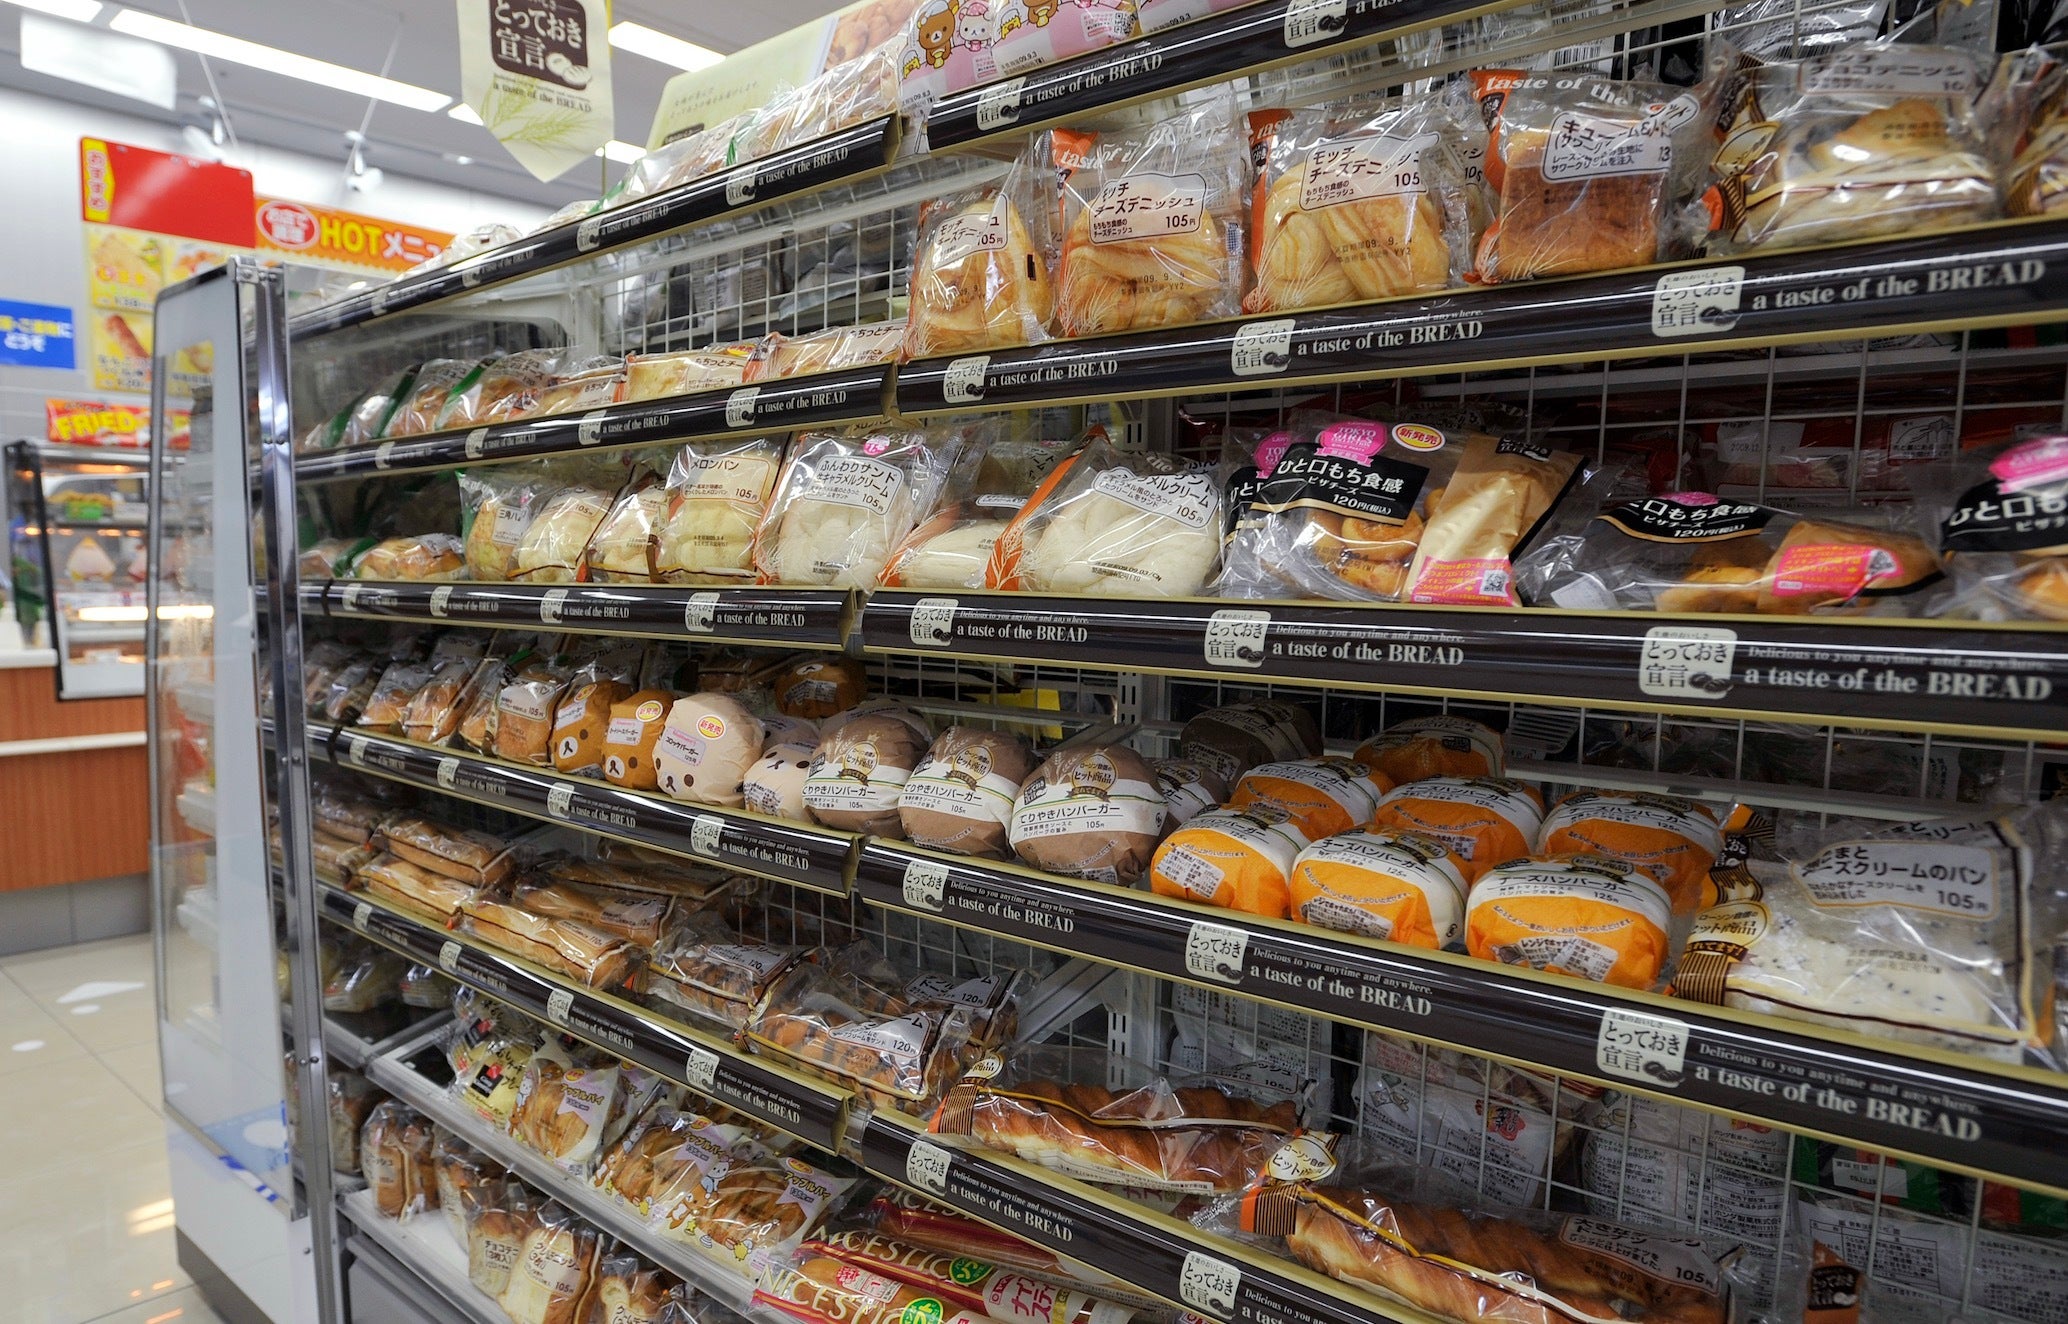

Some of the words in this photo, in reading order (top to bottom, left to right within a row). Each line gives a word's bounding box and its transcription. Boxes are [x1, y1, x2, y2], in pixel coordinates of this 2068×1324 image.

[495, 0, 582, 49] とっておき
[1288, 14, 1317, 40] 宣言
[496, 27, 546, 70] 宣言
[1026, 93, 1033, 105] a
[1037, 84, 1066, 102] taste
[1069, 77, 1084, 94] of
[1085, 71, 1105, 89] the
[1108, 53, 1163, 82] BREAD
[1486, 75, 1549, 91] taste
[1556, 75, 1584, 90] of
[1590, 84, 1628, 105] the
[556, 97, 591, 113] BREAD
[1314, 147, 1355, 165] モッチ
[1166, 214, 1195, 228] 105円
[1659, 276, 1736, 301] とっておき
[1752, 294, 1767, 310] a
[1775, 286, 1834, 308] taste
[1842, 278, 1872, 301] of
[1876, 275, 1918, 297] the
[1927, 259, 2046, 292] BREAD
[1658, 303, 1699, 328] 宣言
[1236, 328, 1288, 347] とっておき
[1298, 343, 1307, 355] a
[1312, 337, 1350, 353] taste
[1356, 332, 1373, 349] of
[1378, 329, 1404, 347] the
[1410, 320, 1483, 344] BREAD
[1235, 348, 1263, 368] 宣言
[990, 376, 997, 387] a
[1000, 373, 1027, 386] taste
[1030, 369, 1043, 383] of
[1045, 366, 1064, 381] the
[1067, 359, 1118, 379] BREAD
[1399, 428, 1442, 445] 新発売
[691, 459, 739, 470] メロンパン
[820, 461, 897, 484] ふんわりサンド
[1277, 459, 1404, 493] ひと口もち食感
[1177, 505, 1204, 523] 105円
[913, 608, 950, 622] とっておき
[913, 623, 932, 640] 宣言
[957, 625, 964, 636] a
[968, 624, 996, 638] taste
[998, 624, 1012, 638] of
[1014, 625, 1032, 640] the
[1037, 625, 1088, 643] BREAD
[1210, 622, 1263, 639] とっておき
[1208, 639, 1236, 659] 宣言
[1273, 641, 1282, 655] a
[1288, 642, 1327, 658] taste
[1332, 642, 1351, 659] of
[1356, 645, 1382, 662] the
[1388, 644, 1464, 666] BREAD
[1647, 643, 1728, 663] とっておき
[1646, 663, 1687, 688] 宣言
[1744, 668, 1760, 684] a
[1768, 668, 1831, 689] taste
[1838, 668, 1868, 691] of
[1875, 669, 1917, 693] the
[1927, 671, 2052, 701] BREAD
[700, 720, 721, 735] 新発売
[905, 783, 982, 801] てりやきハンバーガー
[1020, 804, 1120, 824] てりやきハンバーガー
[1322, 839, 1426, 874] チーズハンバーガー
[906, 869, 943, 890] とっておき
[1501, 874, 1632, 893] チーズハンバーガー
[905, 885, 924, 903] 宣言
[1938, 891, 1988, 911] 105円
[948, 895, 955, 905] a
[958, 895, 985, 913] taste
[988, 903, 1001, 916] of
[1003, 905, 1021, 921] the
[1024, 909, 1074, 933] BREAD
[1190, 932, 1241, 958] とっておき
[1190, 951, 1216, 973] 宣言
[1254, 947, 1292, 964] Delicious
[1294, 956, 1303, 966] to
[1304, 958, 1322, 970] you
[1324, 963, 1361, 980] anytime
[1363, 972, 1381, 984] and
[1383, 976, 1433, 995] anywhere.
[1250, 965, 1260, 977] a
[1265, 966, 1302, 987] taste
[1307, 976, 1325, 993] of
[1329, 981, 1355, 999] the
[1359, 985, 1432, 1017] BREAD
[1605, 1021, 1680, 1056] とっておき
[1603, 1045, 1643, 1072] 宣言
[1695, 1065, 1709, 1081] a
[1718, 1069, 1776, 1095] taste
[1783, 1083, 1811, 1103] of
[1817, 1088, 1857, 1114] the
[1866, 1098, 1982, 1142] BREAD
[682, 1131, 727, 1160] アップルパイ
[909, 1150, 945, 1177] とっておき
[909, 1166, 928, 1185] 宣言
[784, 1170, 831, 1200] アップルパイ
[950, 1183, 958, 1194] a
[960, 1185, 986, 1206] taste
[989, 1199, 1001, 1213] of
[1003, 1203, 1021, 1221] the
[1024, 1211, 1073, 1242] BREAD
[1184, 1262, 1234, 1297] とっておき
[1676, 1267, 1713, 1288] 105円
[1183, 1281, 1209, 1307] 宣言
[1244, 1288, 1282, 1311] Delicious
[1241, 1306, 1251, 1317] a
